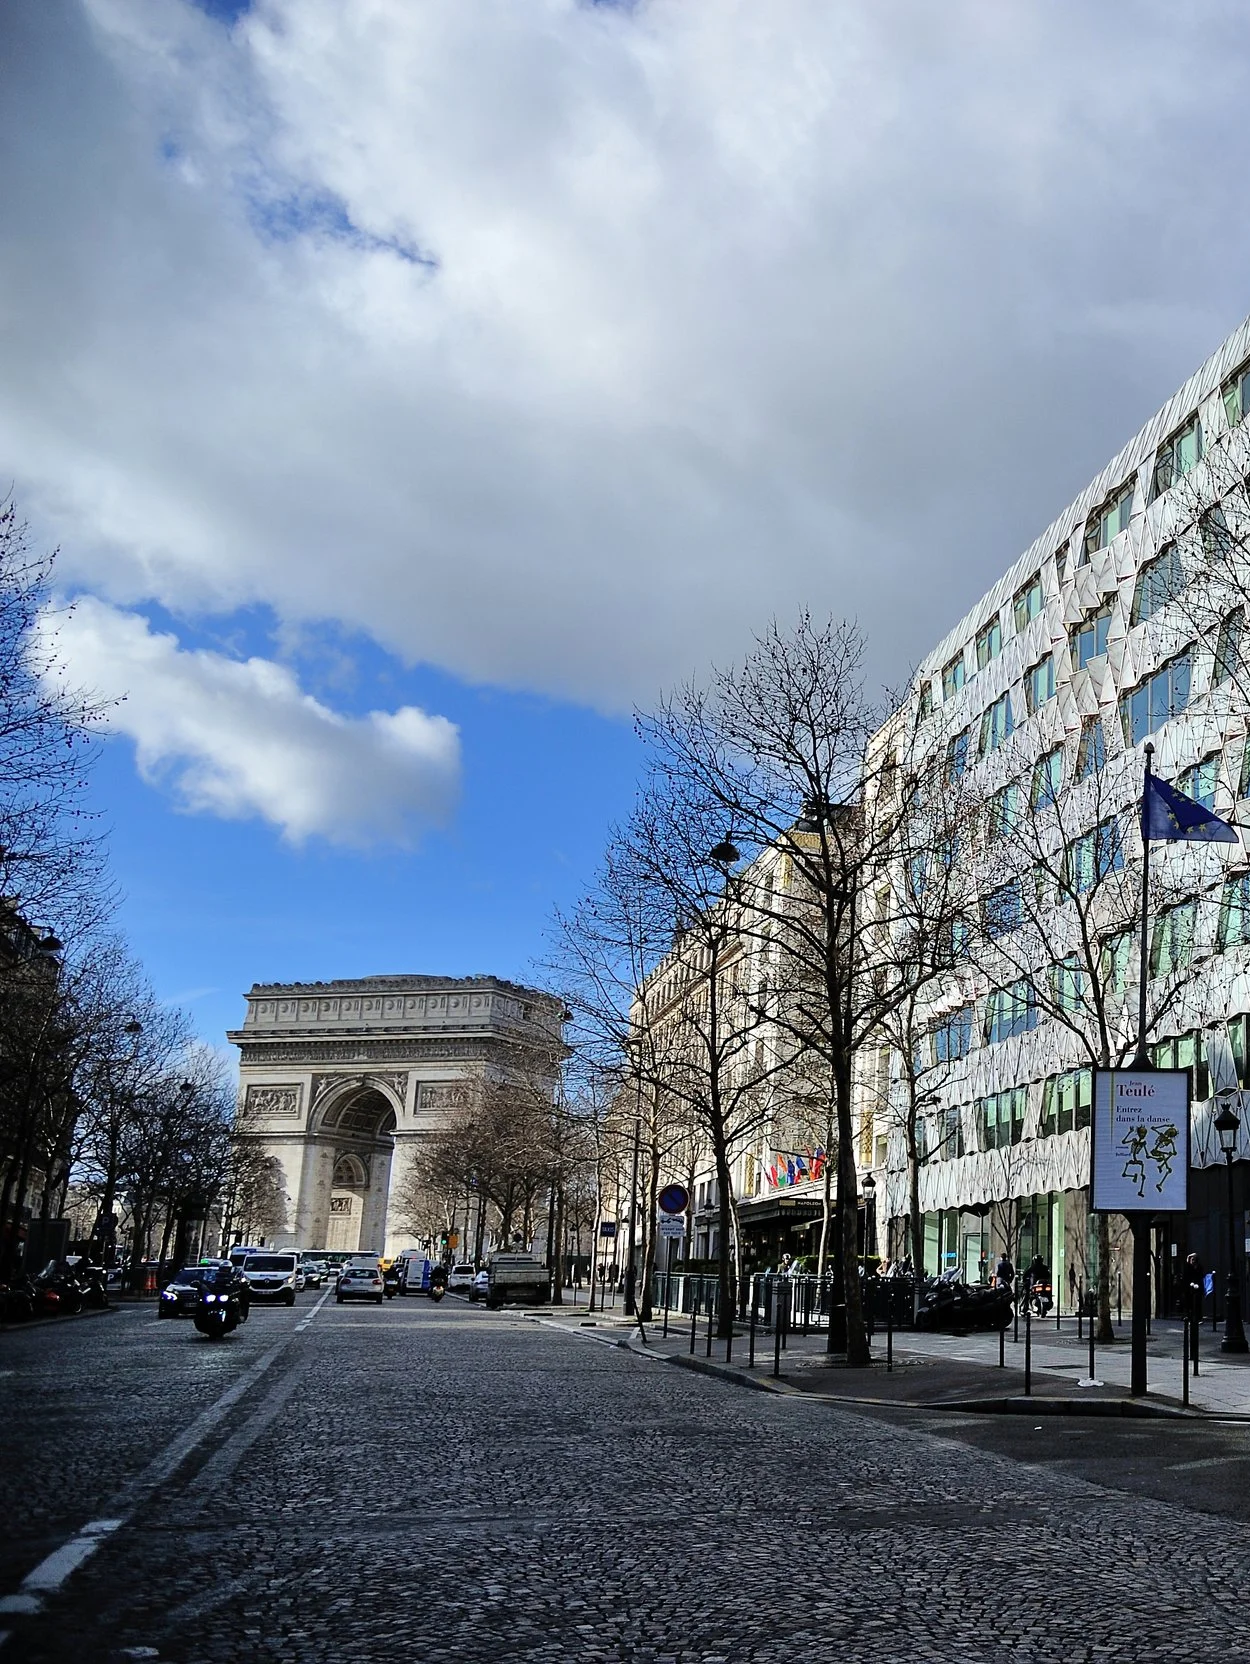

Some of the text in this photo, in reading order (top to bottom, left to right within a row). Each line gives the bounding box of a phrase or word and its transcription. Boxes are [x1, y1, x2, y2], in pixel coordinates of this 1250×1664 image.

[1116, 1084, 1155, 1097] Teulé
[1116, 1105, 1142, 1113] Entrez
[107, 1273, 115, 1281] P
